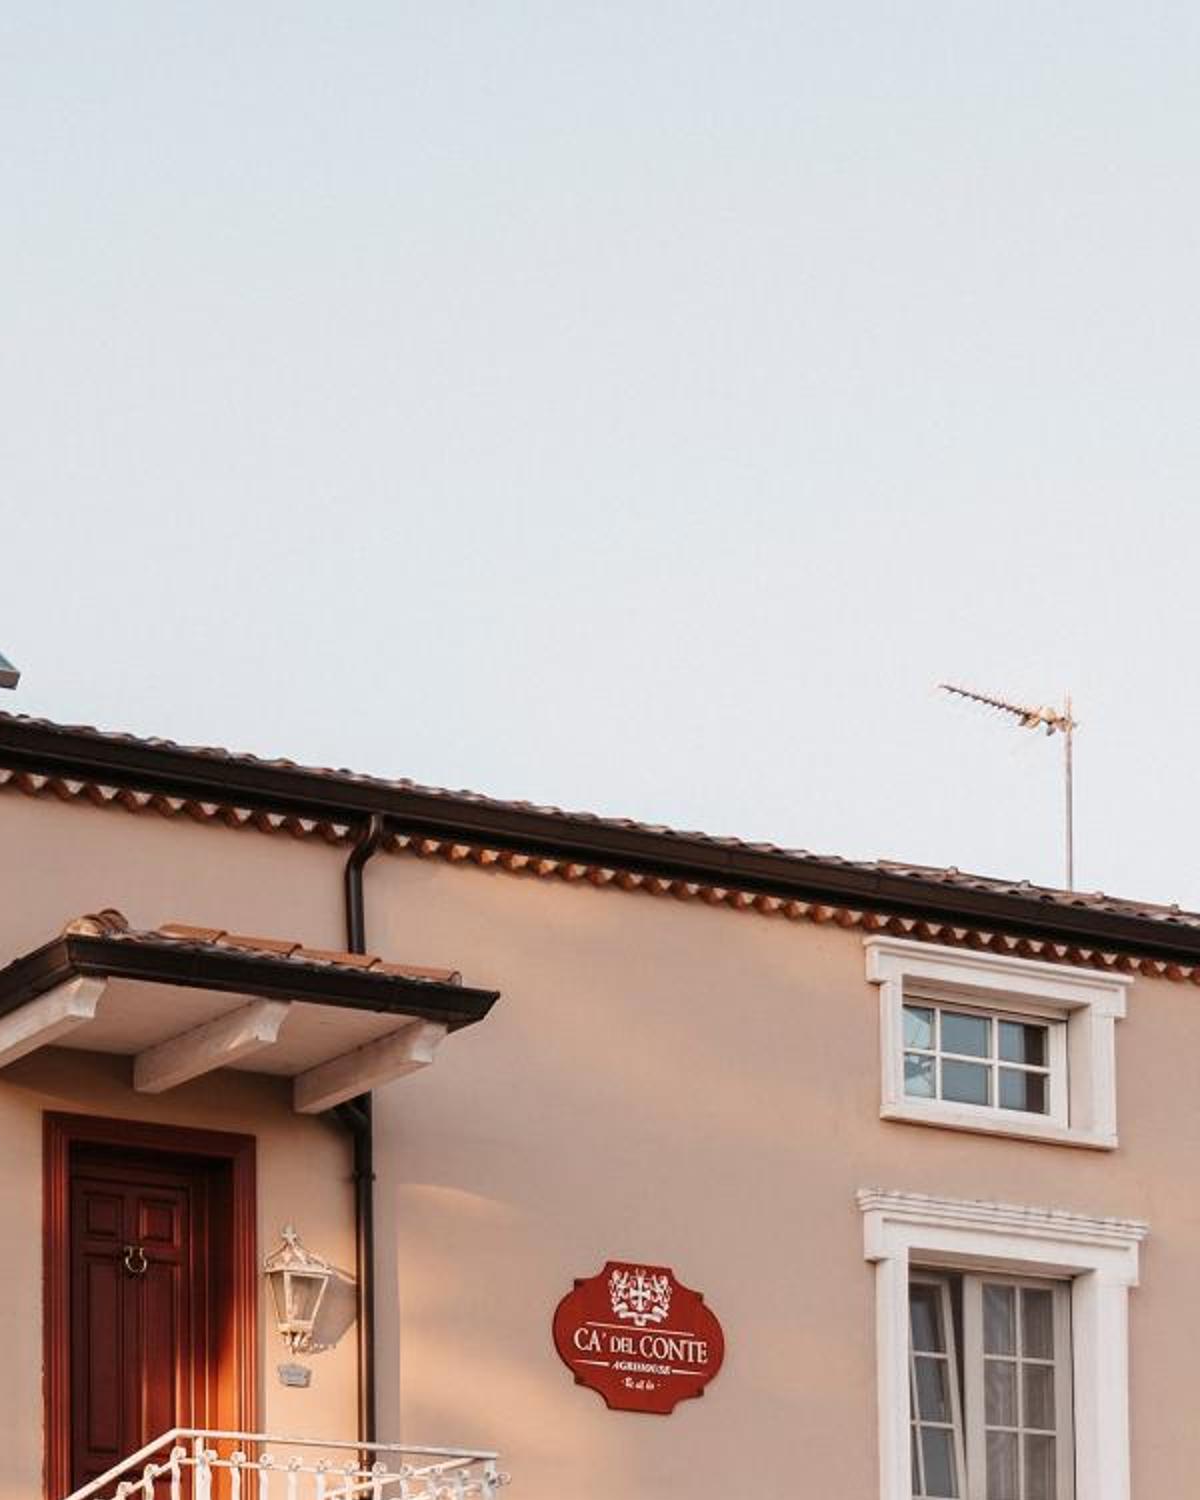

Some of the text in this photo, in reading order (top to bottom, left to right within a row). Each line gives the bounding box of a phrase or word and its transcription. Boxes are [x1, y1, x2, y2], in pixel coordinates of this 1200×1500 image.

[574, 1327, 708, 1364] CA' DEL CONTE
